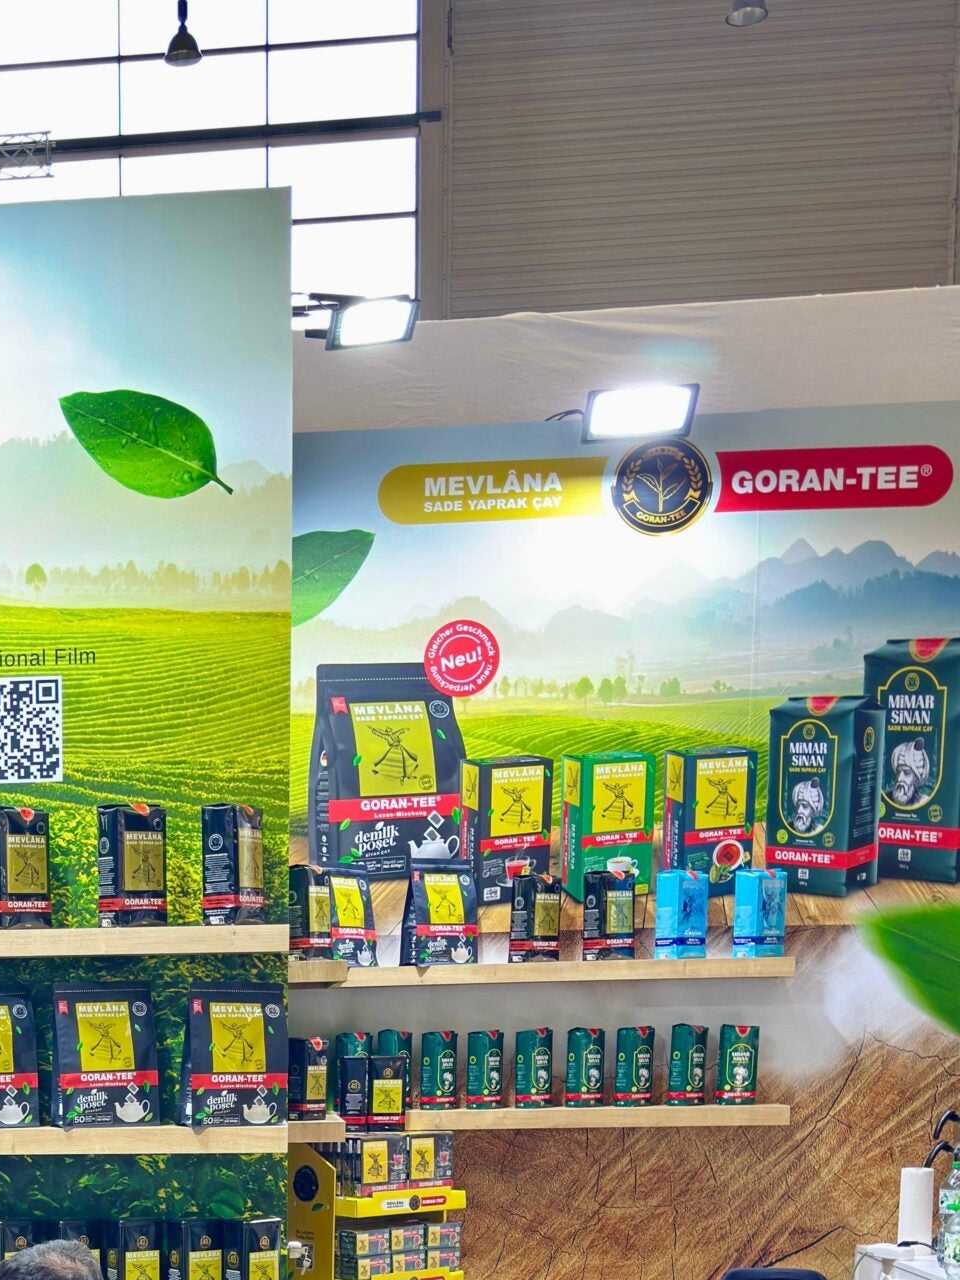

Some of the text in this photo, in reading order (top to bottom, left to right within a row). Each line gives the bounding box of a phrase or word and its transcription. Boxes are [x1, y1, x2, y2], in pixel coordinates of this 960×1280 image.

[424, 469, 563, 497] MEVLÂNA
[424, 496, 562, 512] SADE YAPRAK ÇAY
[636, 509, 687, 524] GORAN-TEE
[428, 624, 496, 659] Gleicher Geschmack
[54, 647, 97, 666] Film
[440, 646, 483, 672] Neu!
[430, 664, 493, 692] neue Verpackung
[353, 703, 423, 715] MEVLÂNA
[354, 824, 400, 844] demlik
[878, 826, 938, 843] ORAN-TEE
[358, 838, 397, 856] poşet
